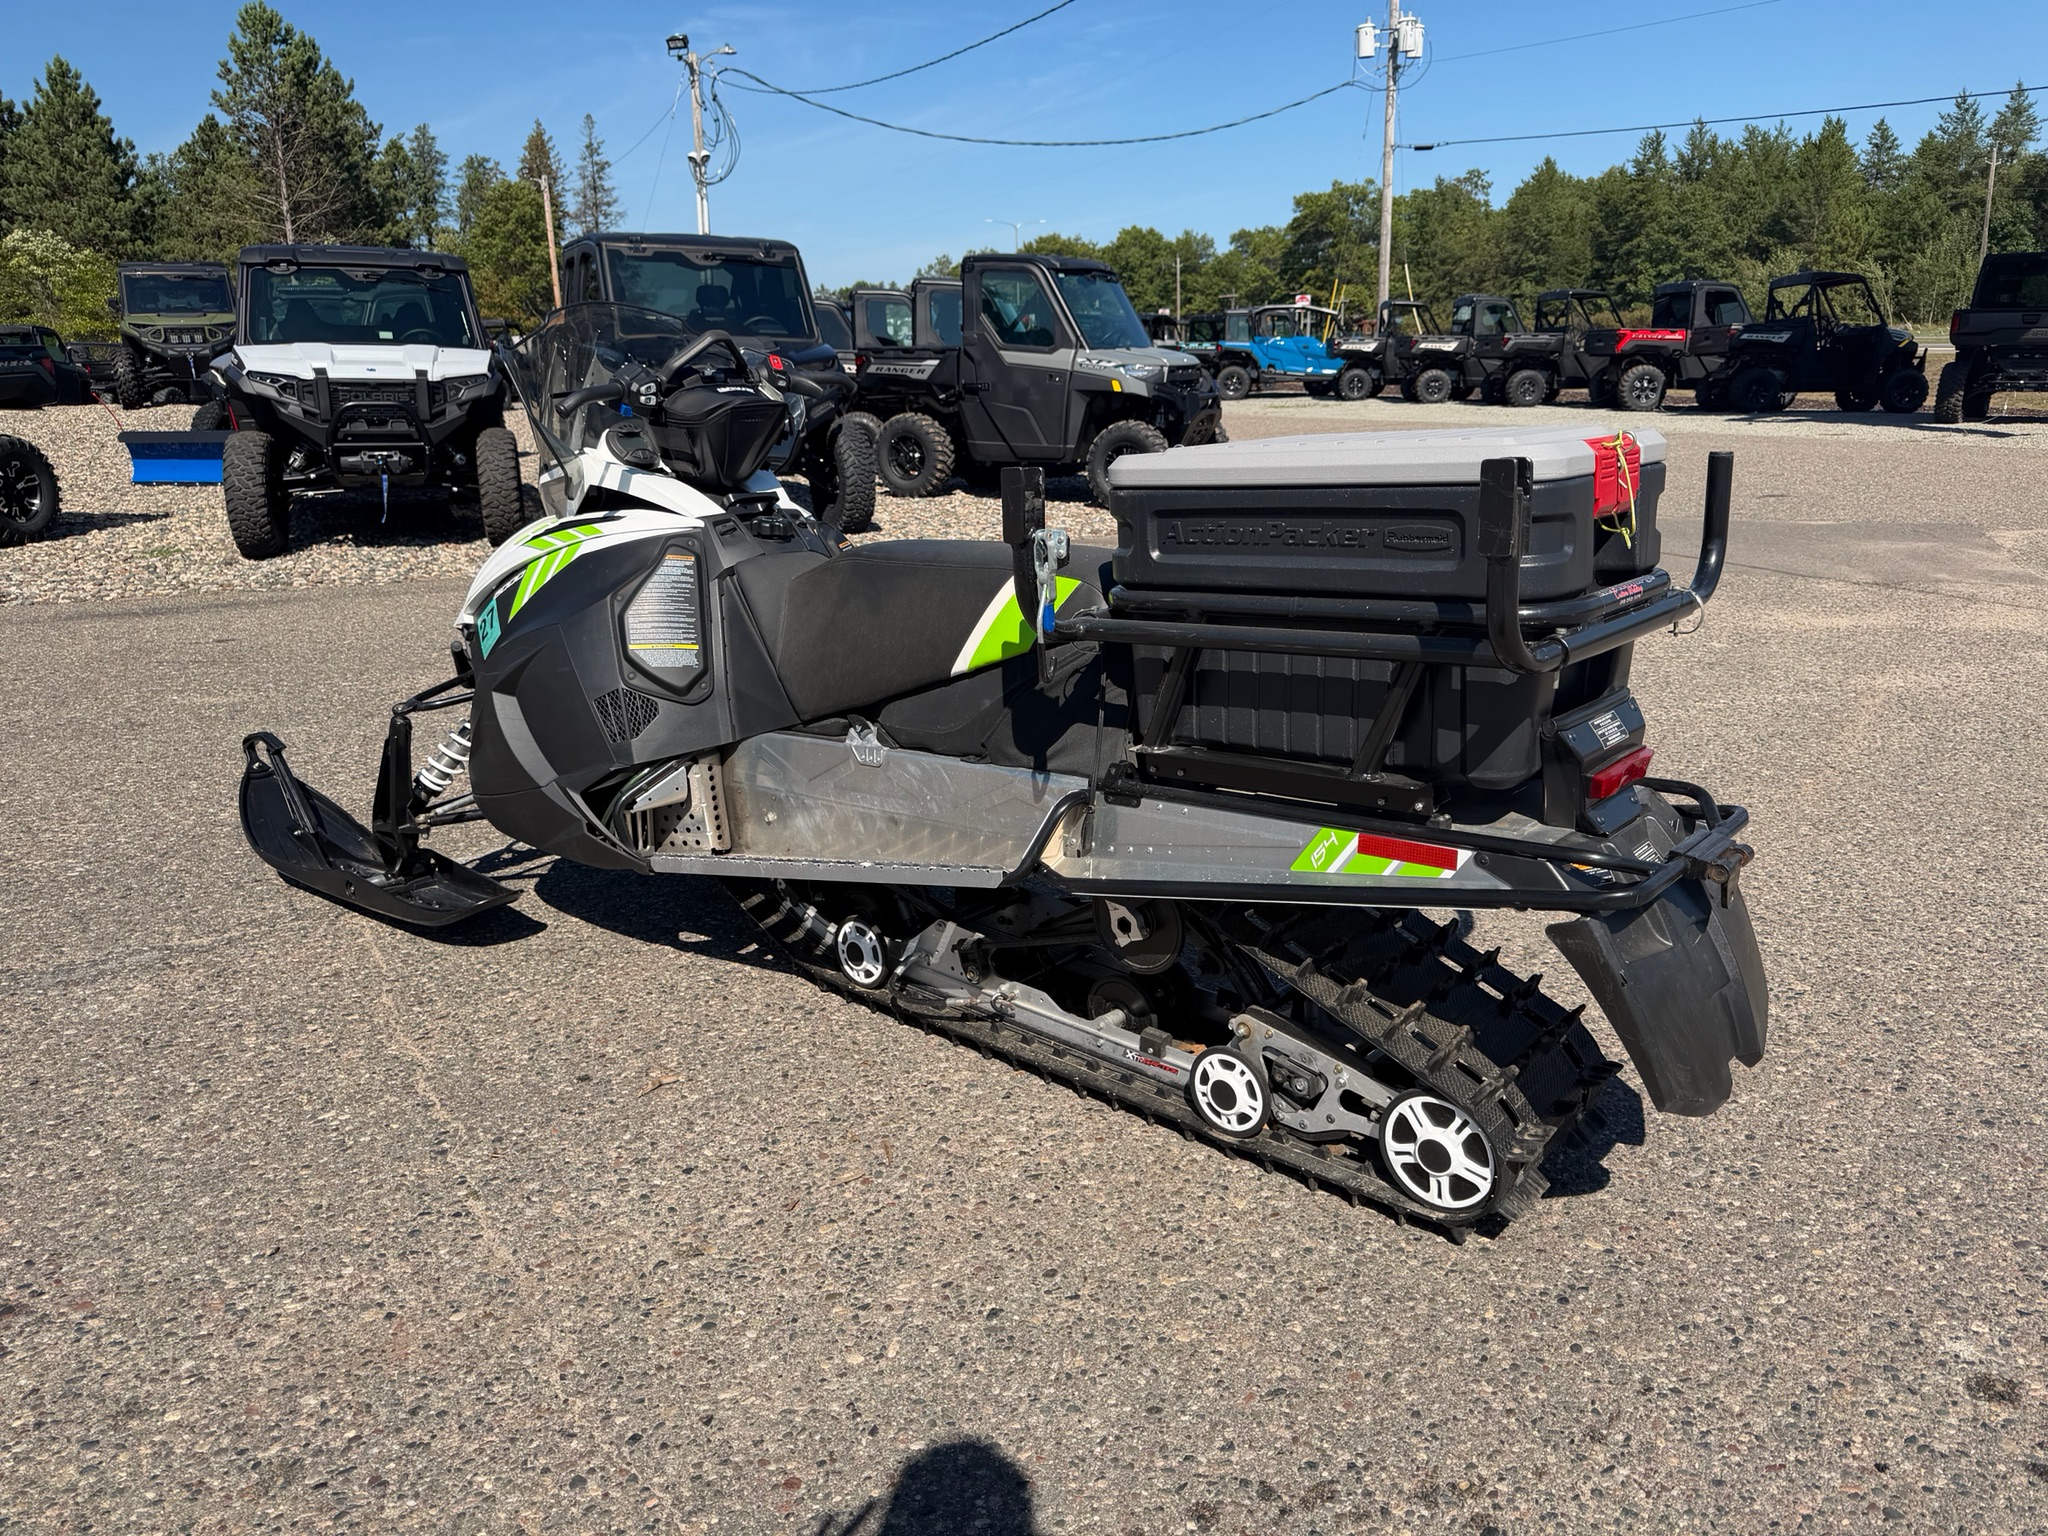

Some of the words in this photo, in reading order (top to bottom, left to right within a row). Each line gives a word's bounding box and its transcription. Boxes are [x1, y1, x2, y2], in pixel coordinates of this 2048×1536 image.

[875, 366, 927, 375] RANGER
[340, 392, 410, 401] POLARIS
[1162, 520, 1378, 549] ActionPacker
[1386, 531, 1450, 545] Rubbermaid
[480, 607, 496, 643] 27
[1310, 831, 1339, 870] 154
